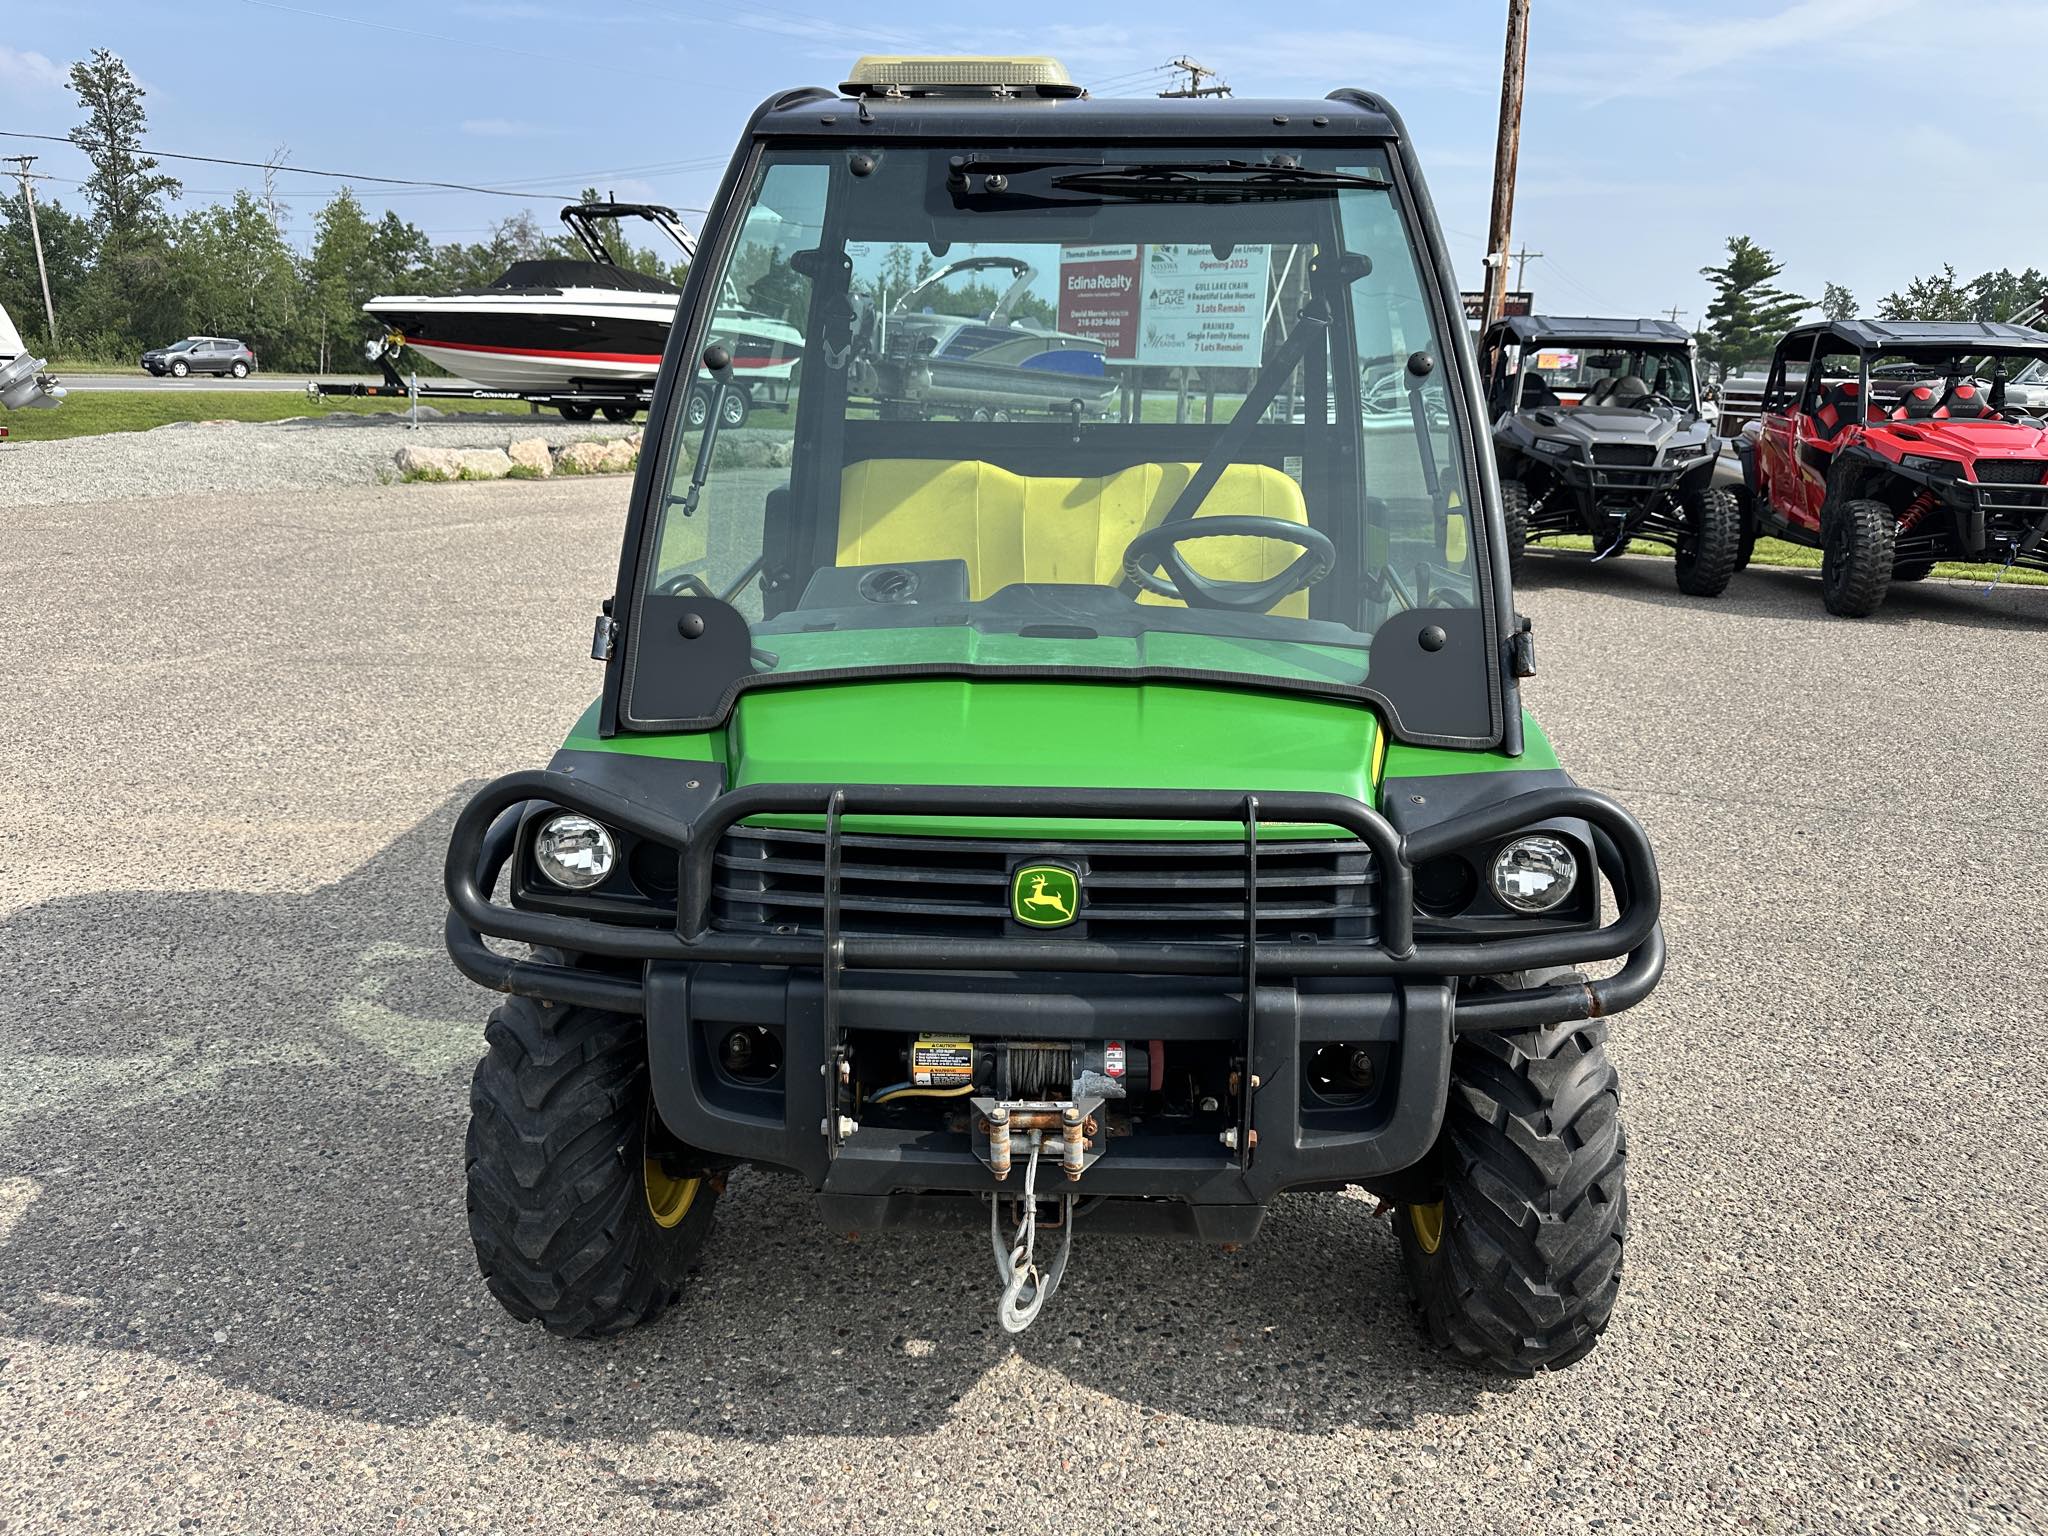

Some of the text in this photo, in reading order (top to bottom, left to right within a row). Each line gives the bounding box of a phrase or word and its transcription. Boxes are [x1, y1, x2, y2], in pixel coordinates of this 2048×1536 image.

[1244, 245, 1263, 254] Living
[1200, 259, 1248, 271] Opening 2025
[1068, 274, 1132, 292] Edina Realty
[1195, 281, 1248, 291] GULL LAKE CHAIN
[1192, 292, 1218, 300] Beautiful
[1235, 291, 1255, 299] Homes
[1159, 296, 1184, 305] LAKE
[1195, 304, 1200, 313] 3
[1202, 304, 1217, 313] Lots
[1218, 303, 1245, 312] Remain
[1203, 322, 1234, 330] BRAINERD
[1187, 332, 1250, 341] Single Family Homes
[1194, 343, 1243, 352] 7 Lots Remain
